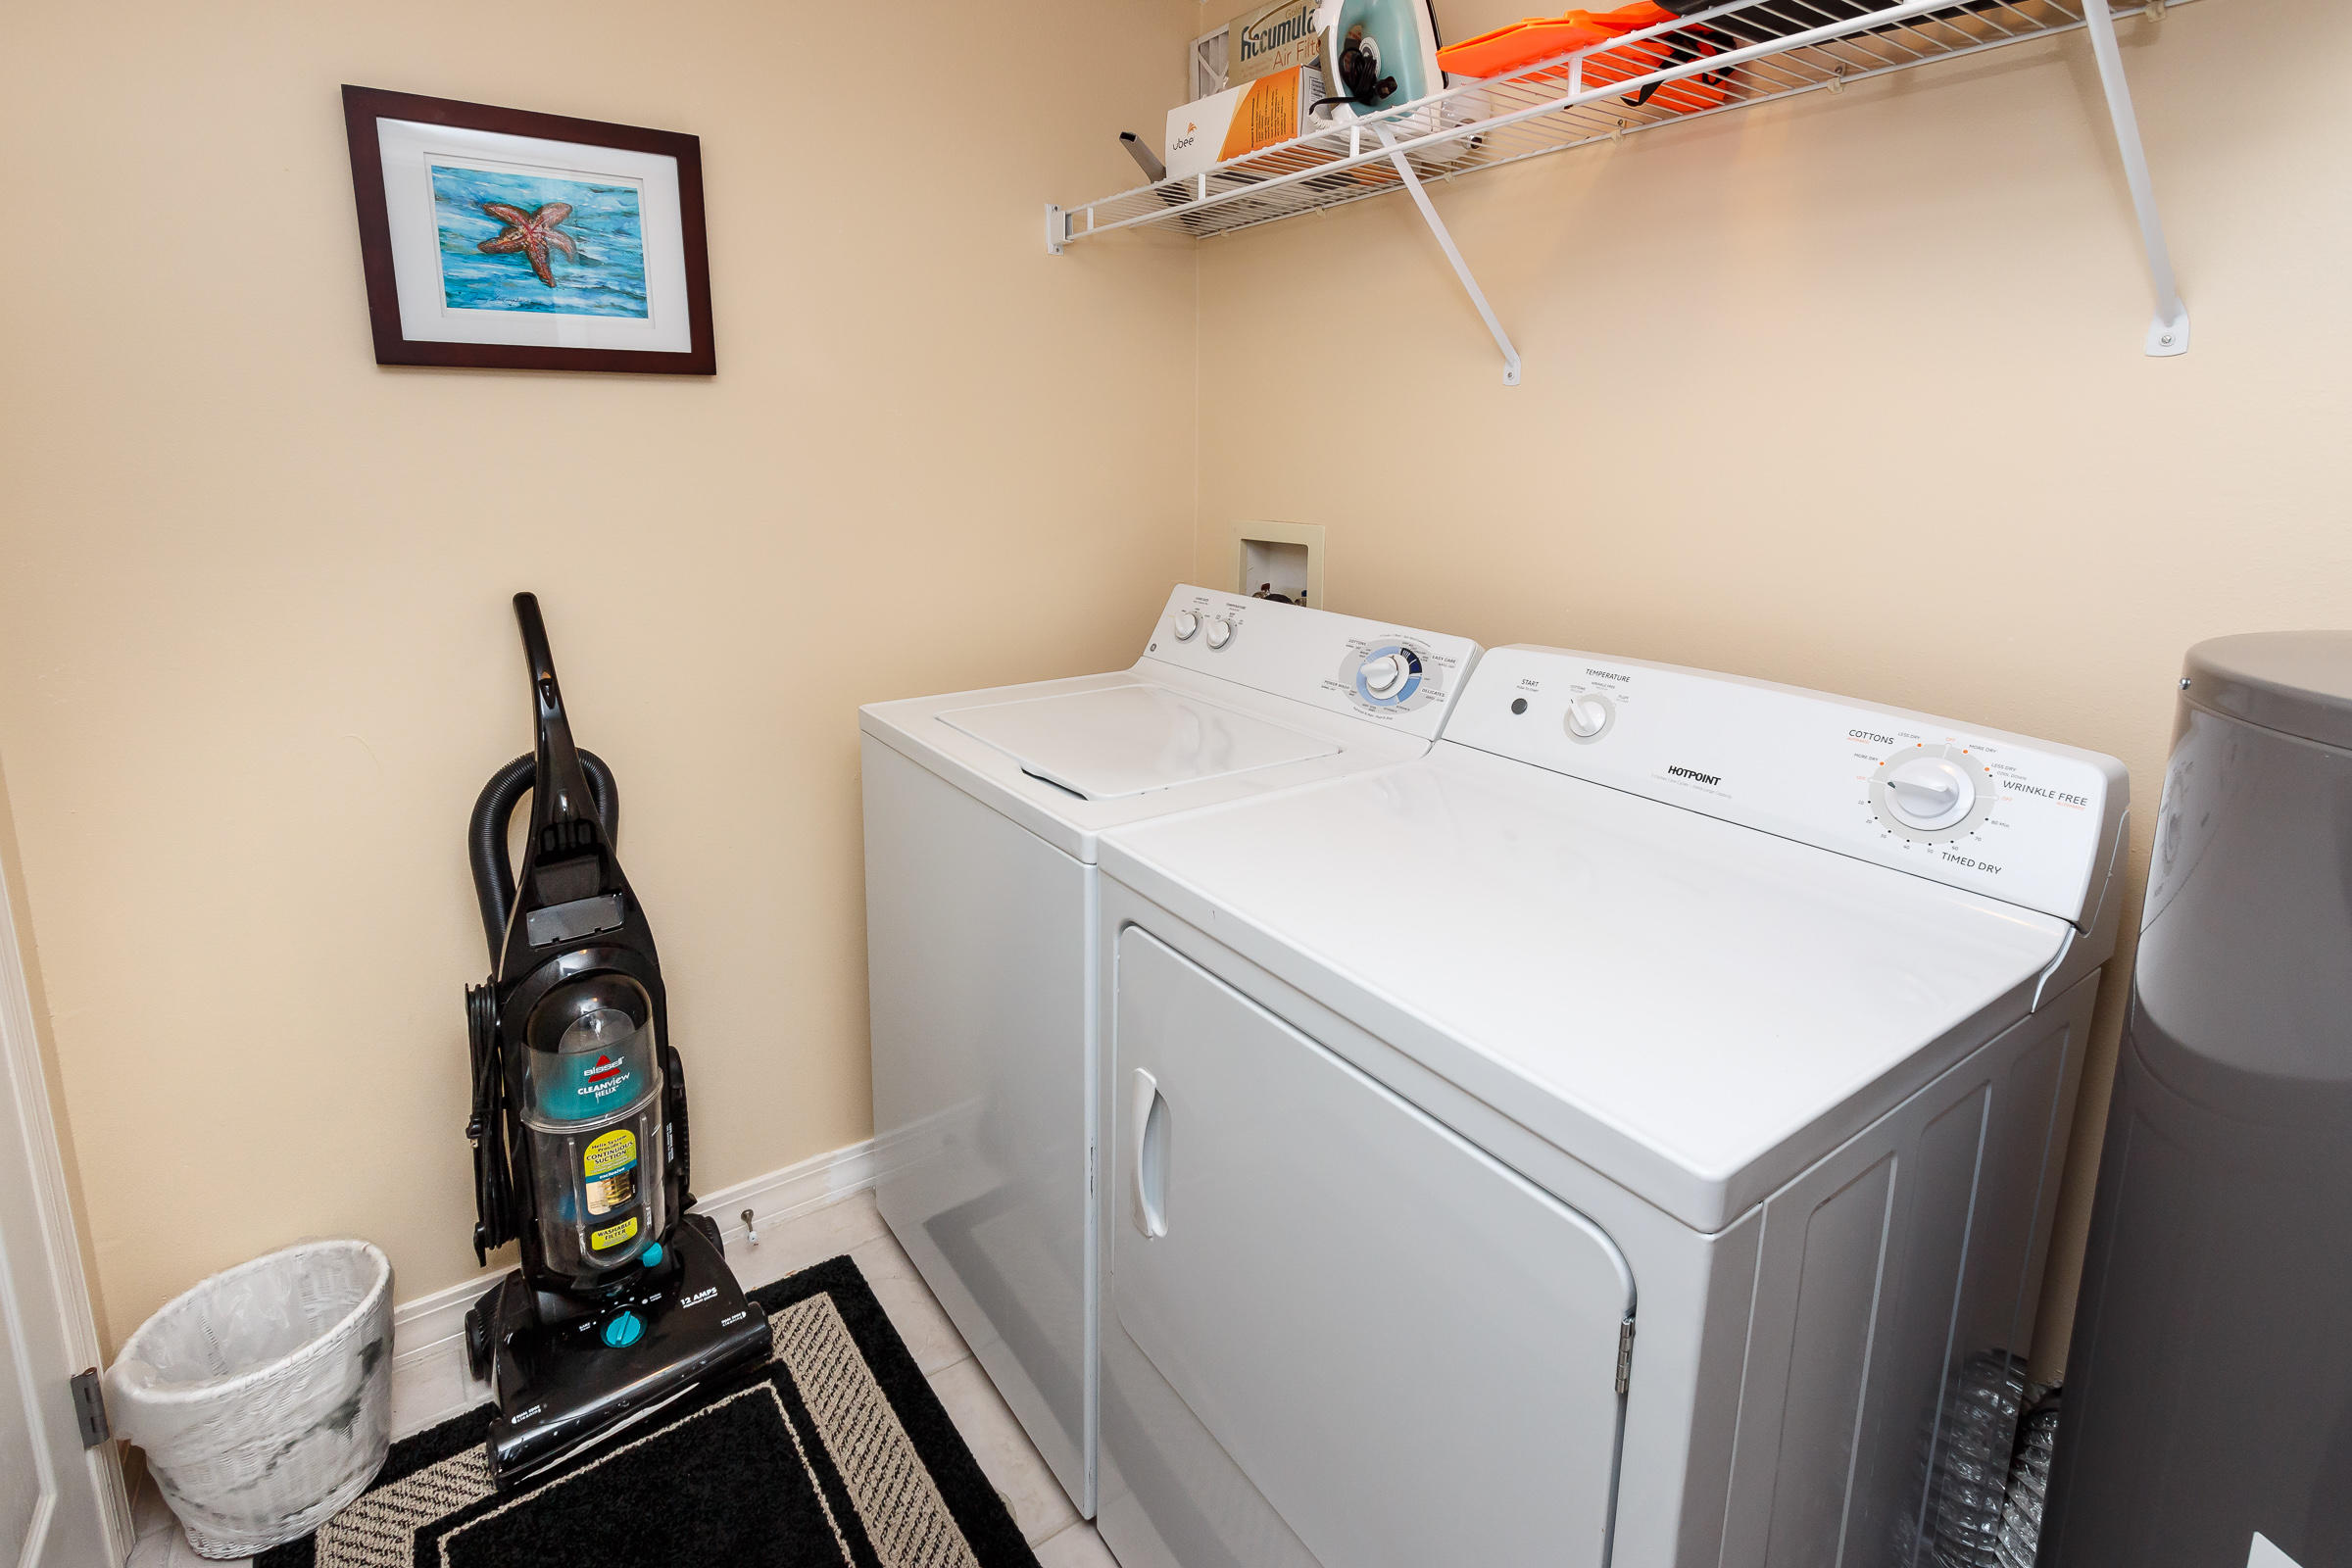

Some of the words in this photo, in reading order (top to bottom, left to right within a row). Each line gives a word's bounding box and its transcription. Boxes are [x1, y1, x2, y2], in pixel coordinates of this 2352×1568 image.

[1273, 48, 1292, 70] Air
[1173, 137, 1194, 150] ubee
[1586, 668, 1631, 683] TEMPERATURE
[1848, 729, 1894, 745] COTTONS
[1668, 765, 1721, 785] HOTPOINT
[2003, 779, 2056, 799] WRINKLE
[2058, 792, 2088, 807] FREE
[1941, 852, 1976, 867] TIMED
[1978, 861, 2002, 875] DRY
[586, 1141, 633, 1161] CONTINUOUS
[595, 1150, 627, 1164] SUCTION
[598, 1221, 631, 1237] WASHABLE
[605, 1229, 626, 1241] FILTER
[680, 1297, 692, 1305] 12
[693, 1287, 717, 1300] AMPS
